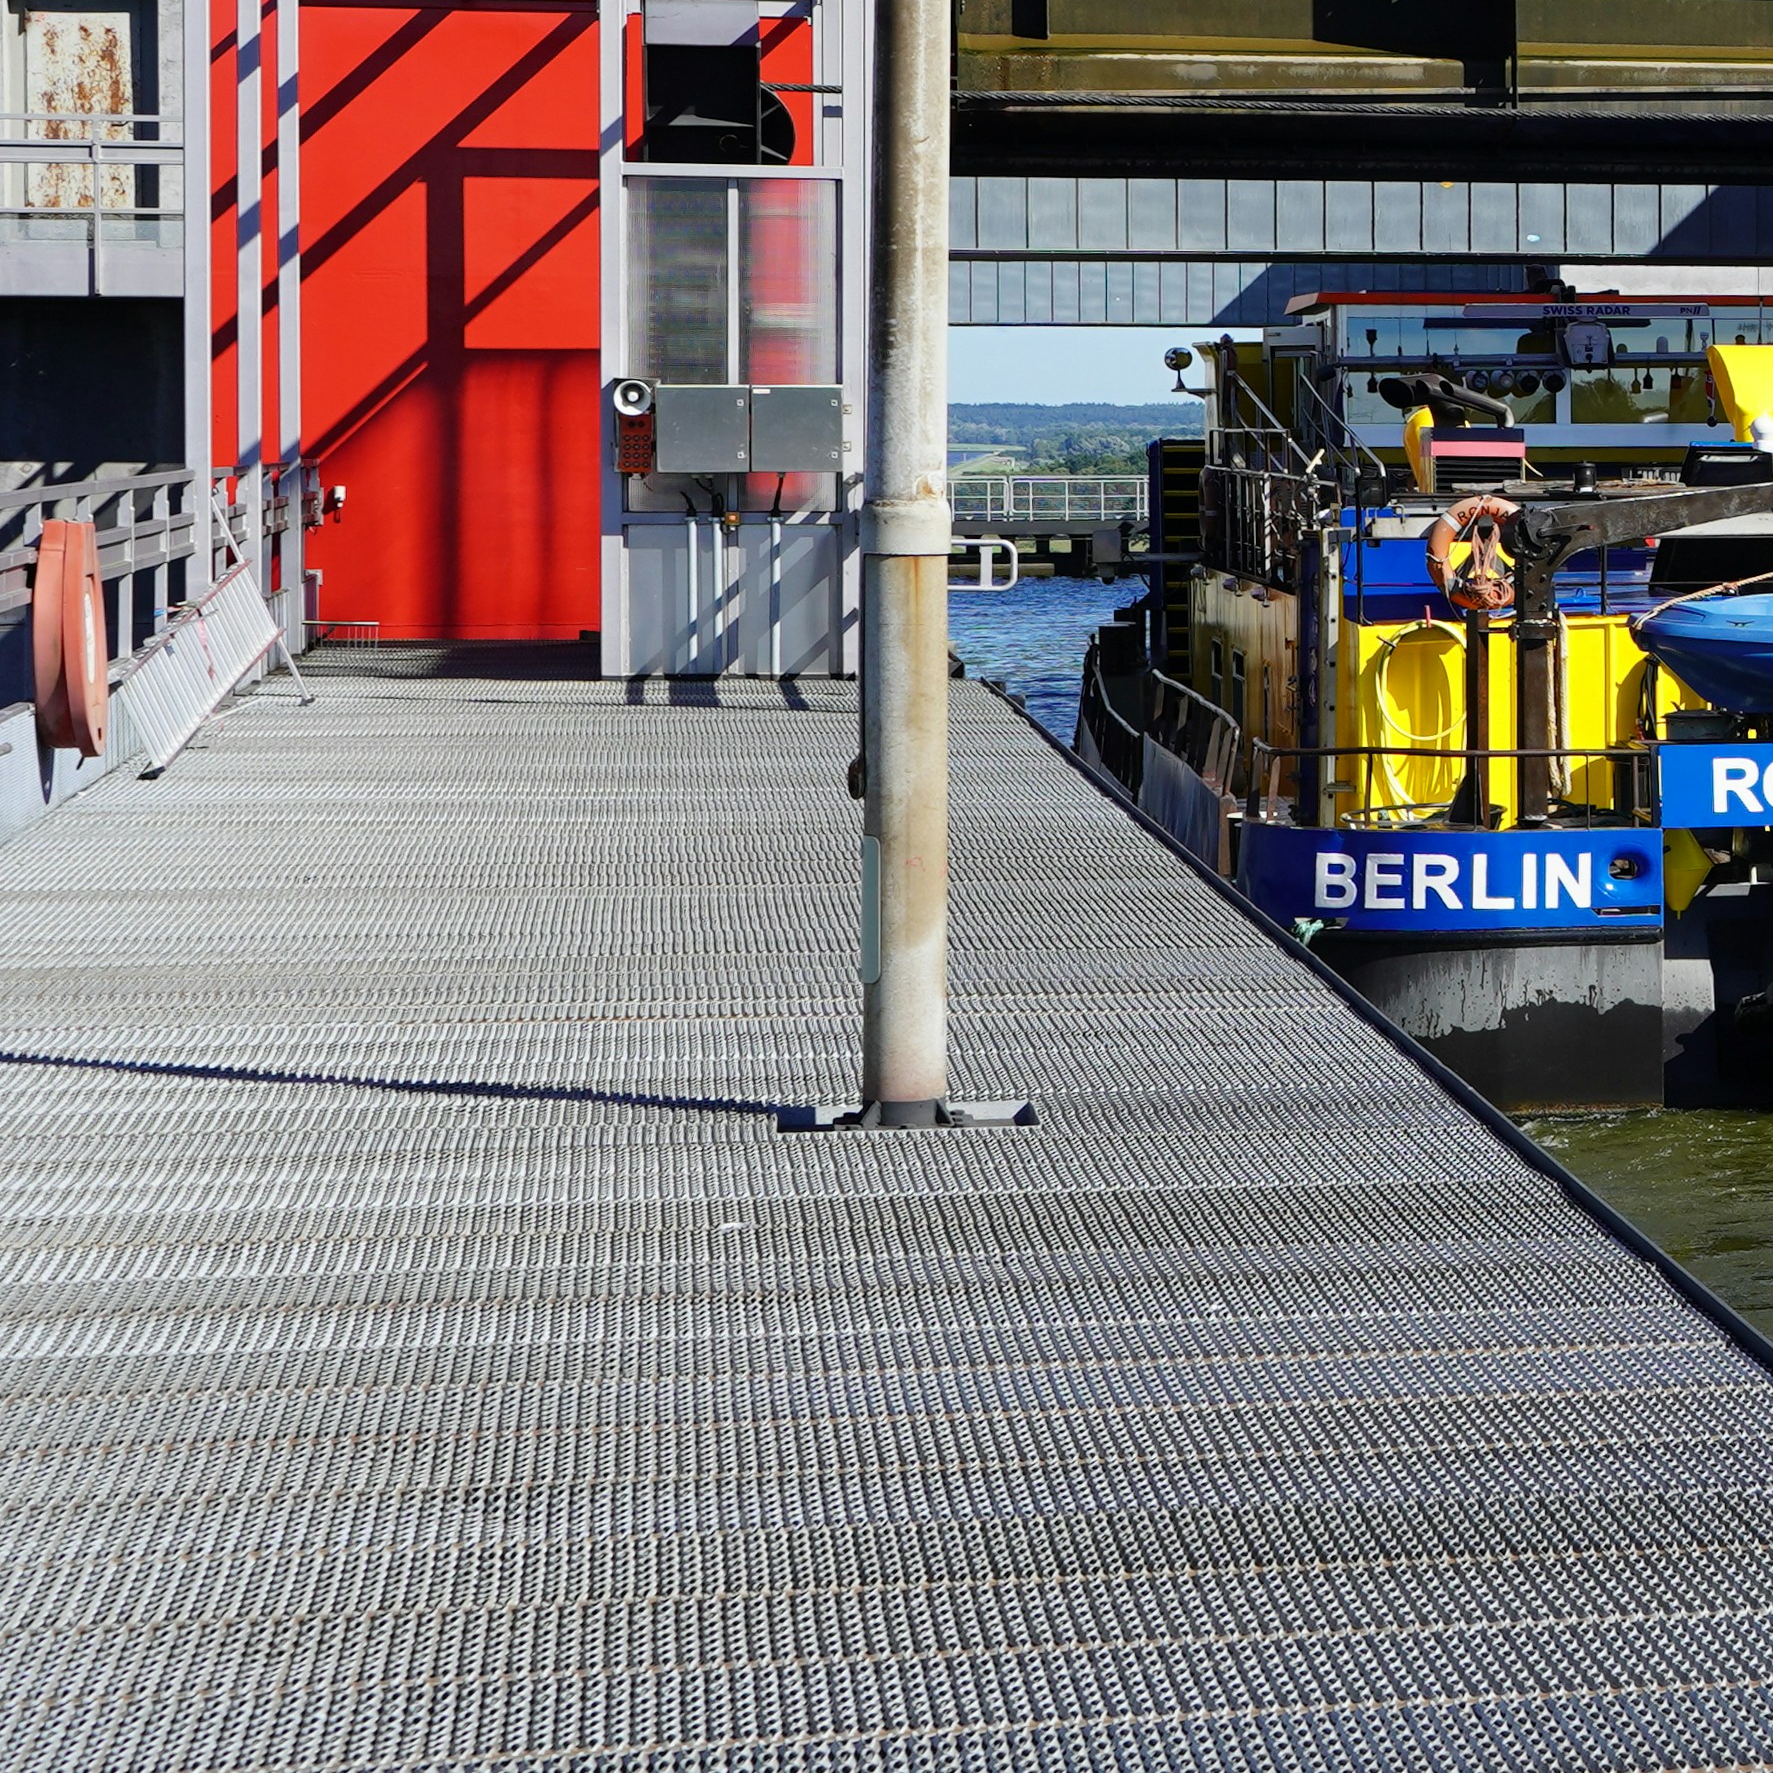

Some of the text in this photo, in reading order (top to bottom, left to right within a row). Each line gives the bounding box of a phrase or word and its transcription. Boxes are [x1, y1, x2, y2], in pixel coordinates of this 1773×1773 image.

[1543, 306, 1631, 316] SWISS RADAR
[1457, 505, 1510, 522] RONJA
[1314, 851, 1592, 911] BERLIN
